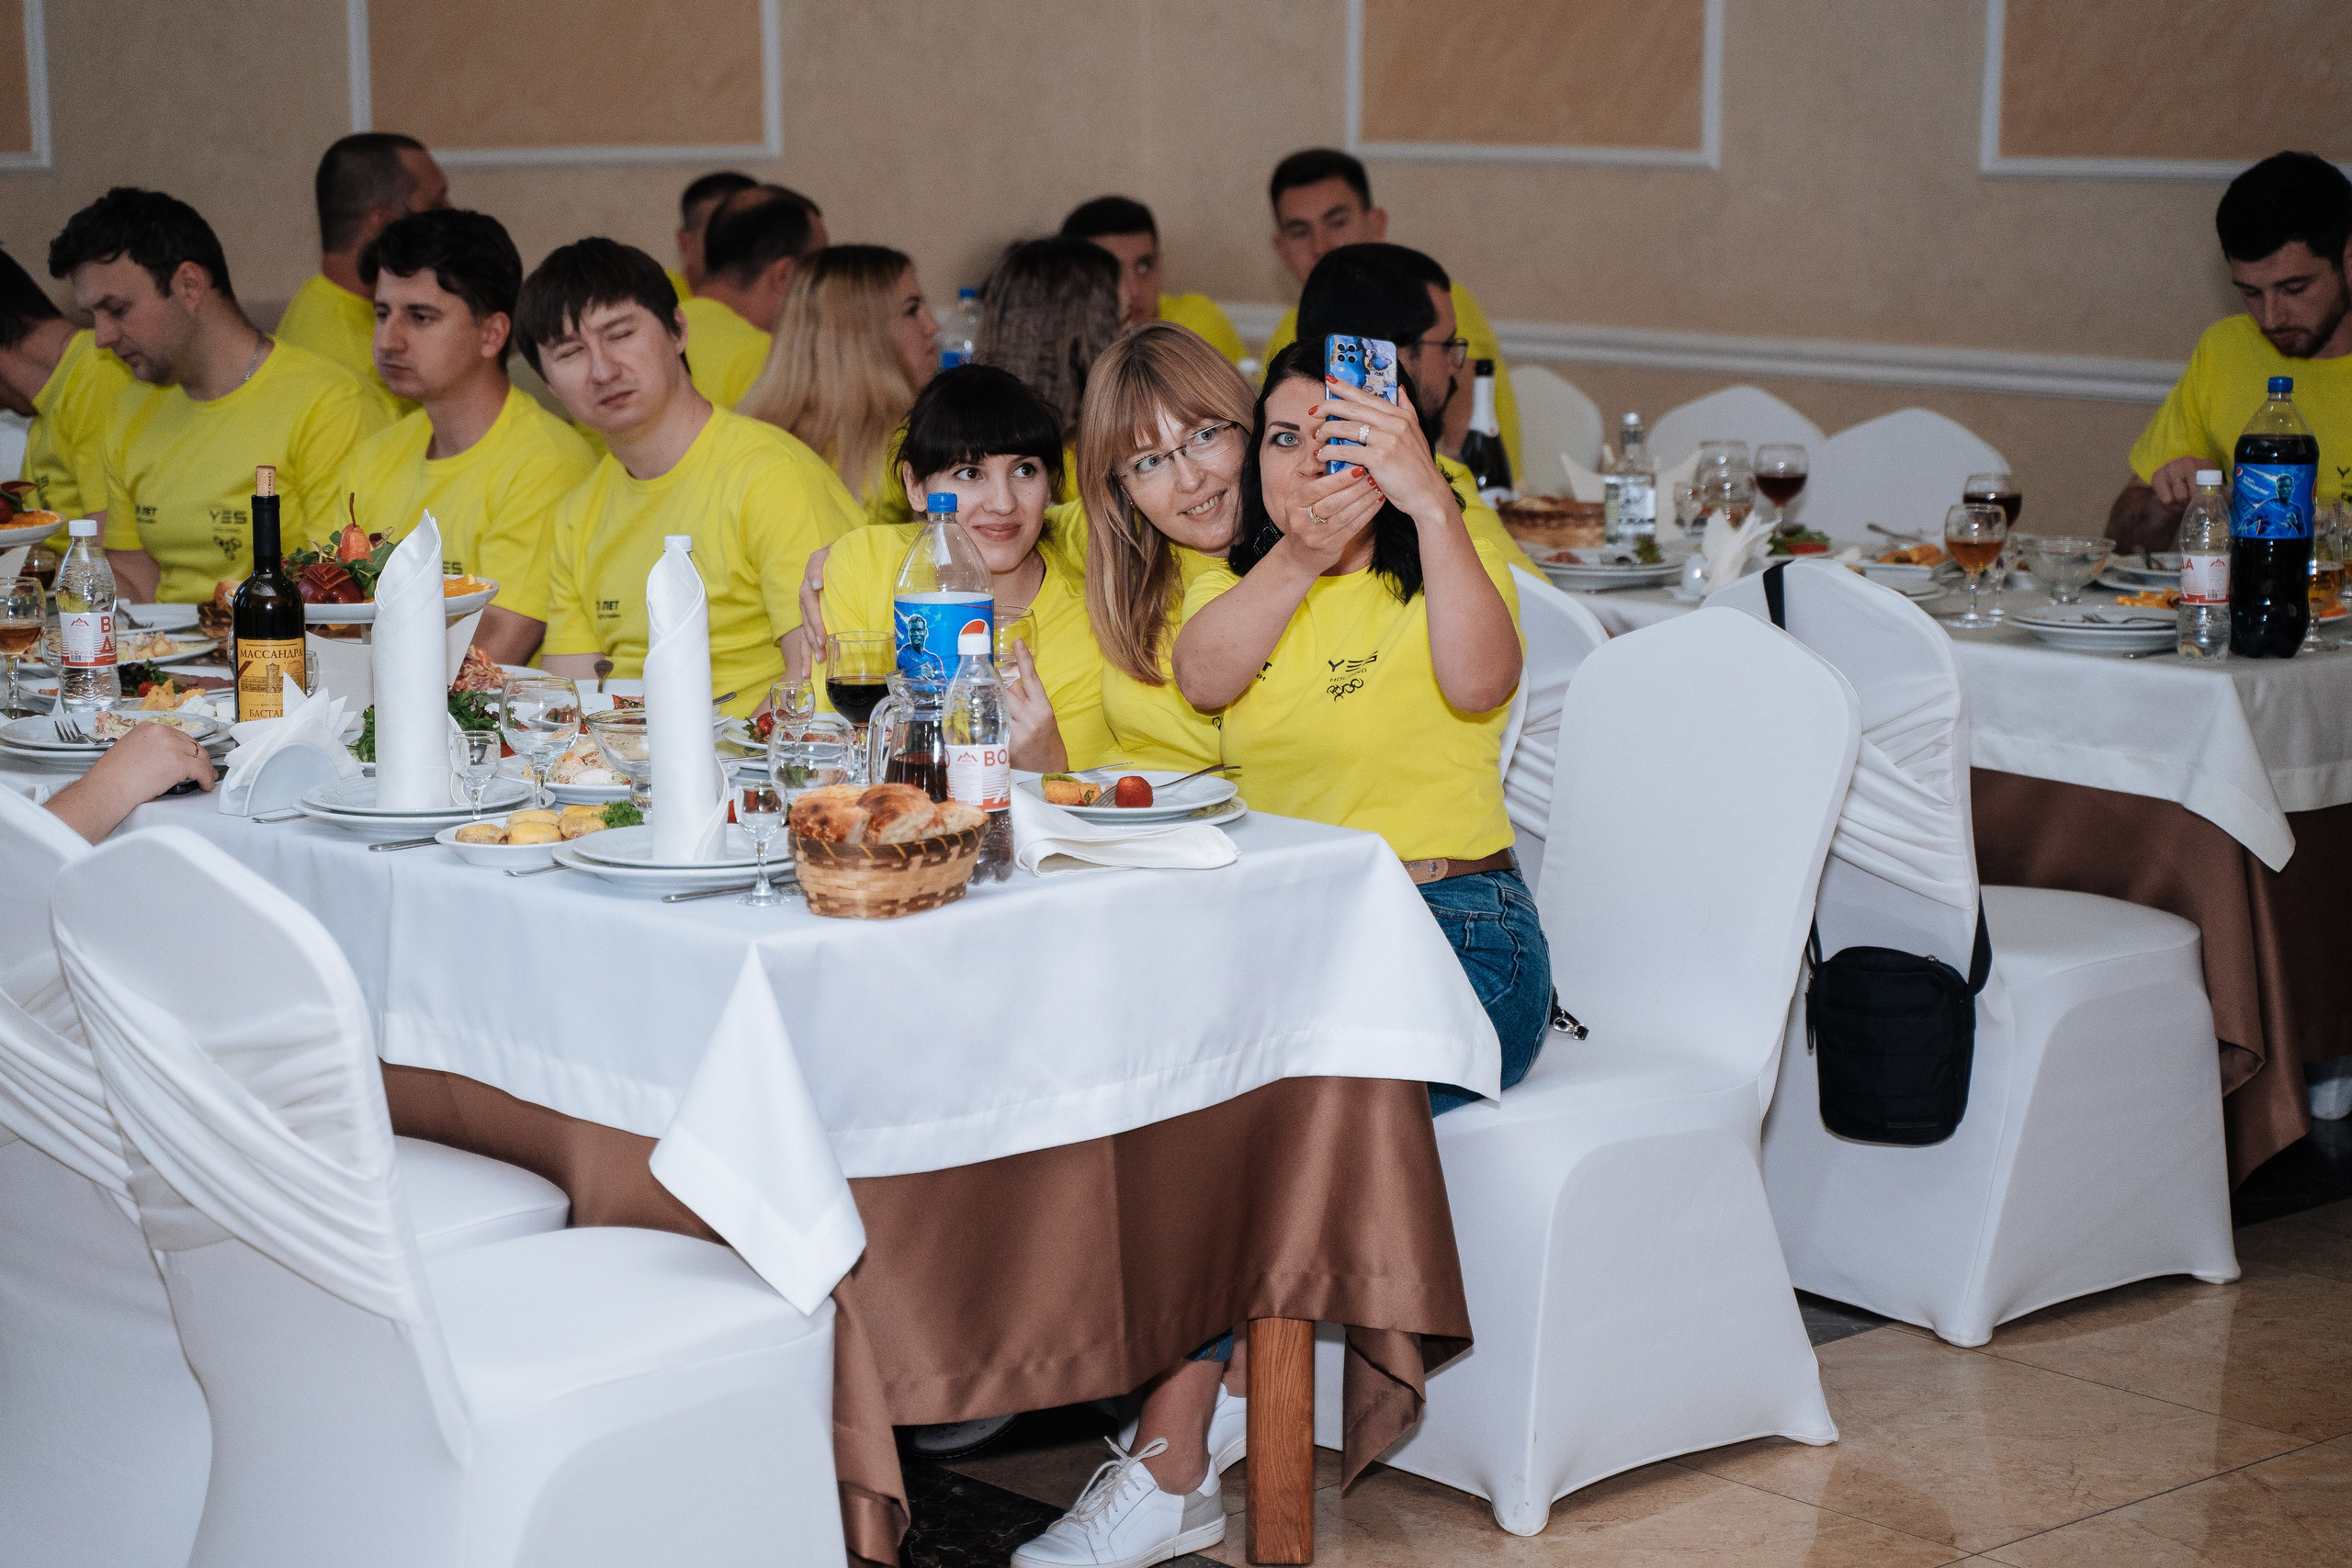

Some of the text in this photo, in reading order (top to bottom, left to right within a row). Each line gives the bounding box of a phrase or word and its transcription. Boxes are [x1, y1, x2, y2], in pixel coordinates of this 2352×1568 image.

[209, 509, 248, 525] YES
[442, 561, 463, 575] ES
[240, 648, 303, 660] МАССАНДРА
